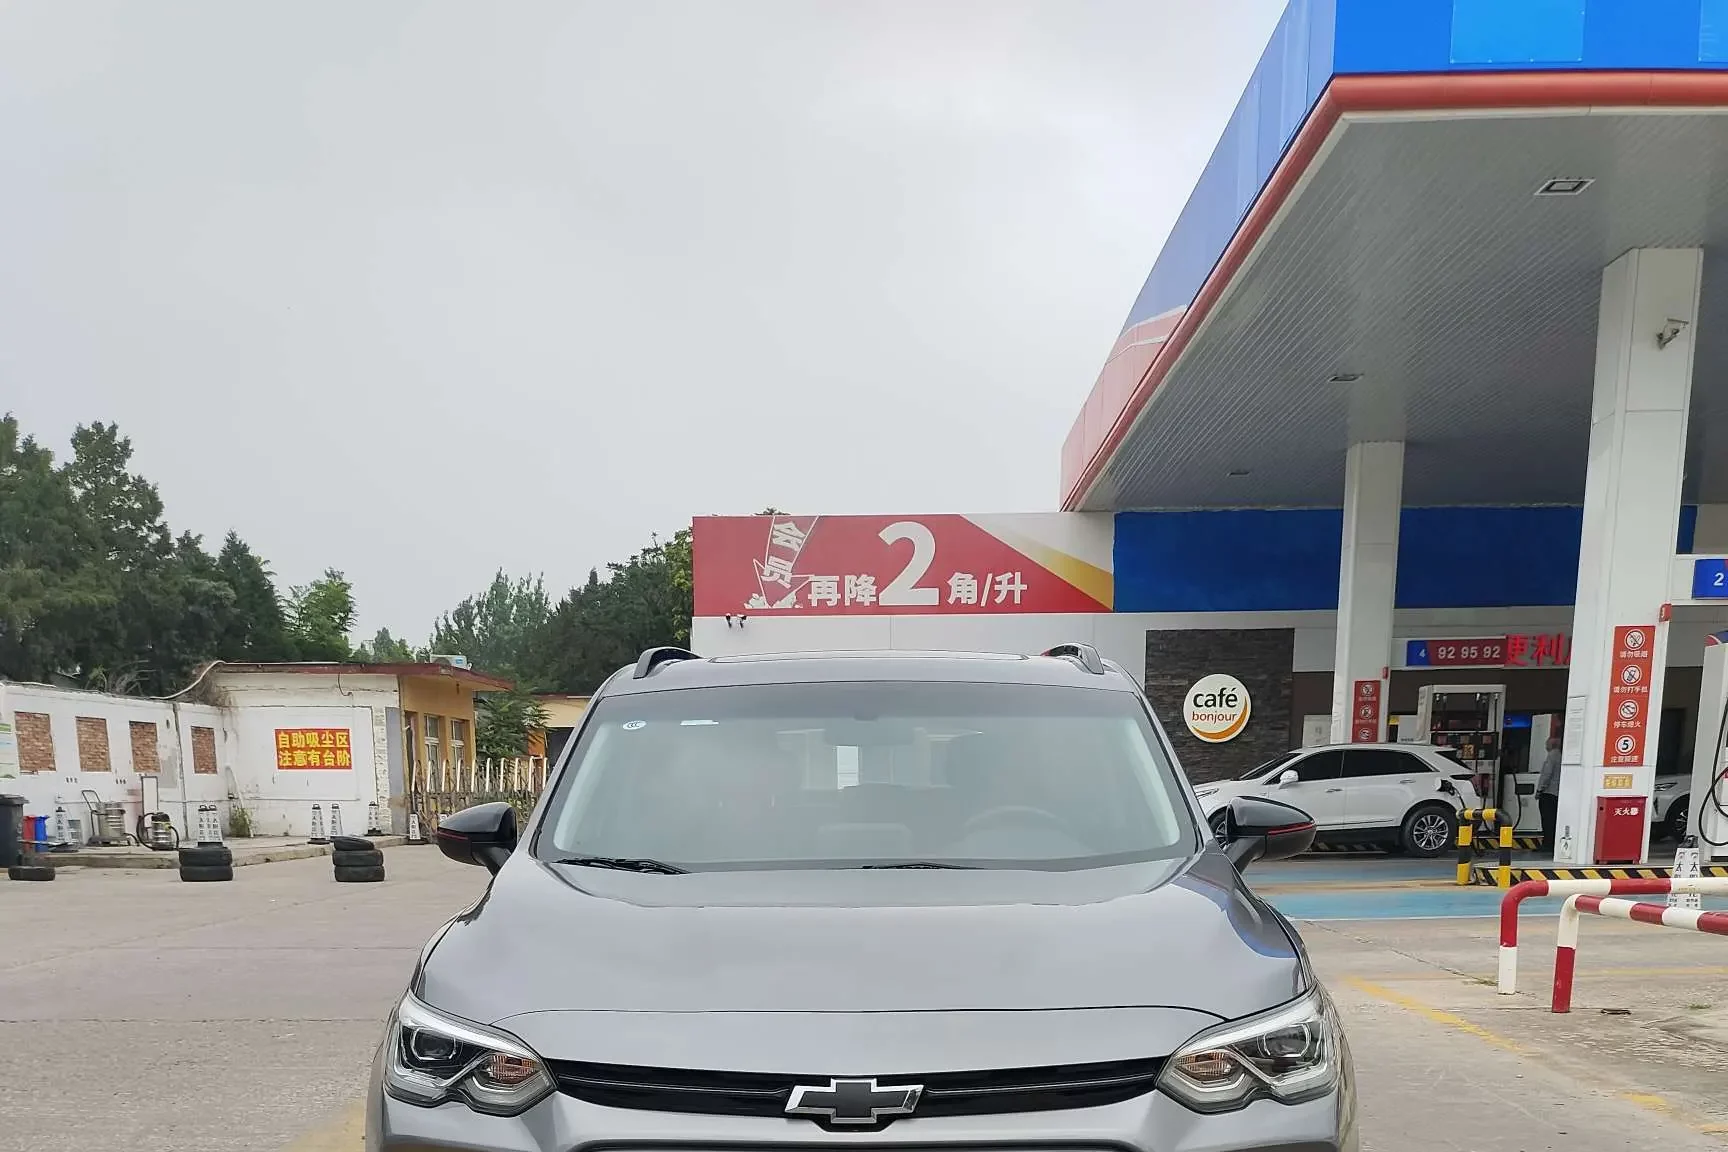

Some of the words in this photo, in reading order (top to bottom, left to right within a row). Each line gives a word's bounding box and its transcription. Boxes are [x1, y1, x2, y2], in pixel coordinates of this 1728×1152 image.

[761, 521, 807, 589] 会员
[1713, 572, 1724, 586] 2
[1419, 649, 1426, 658] 4
[1438, 647, 1456, 660] 92
[1461, 647, 1478, 659] 95
[1483, 646, 1501, 659] 92
[1503, 632, 1572, 667] 便利
[1193, 687, 1238, 708] café
[1192, 710, 1237, 724] bonjour
[278, 730, 350, 749] 自助吸尘区
[1621, 739, 1630, 751] 5
[279, 749, 351, 767] 注意有台阶
